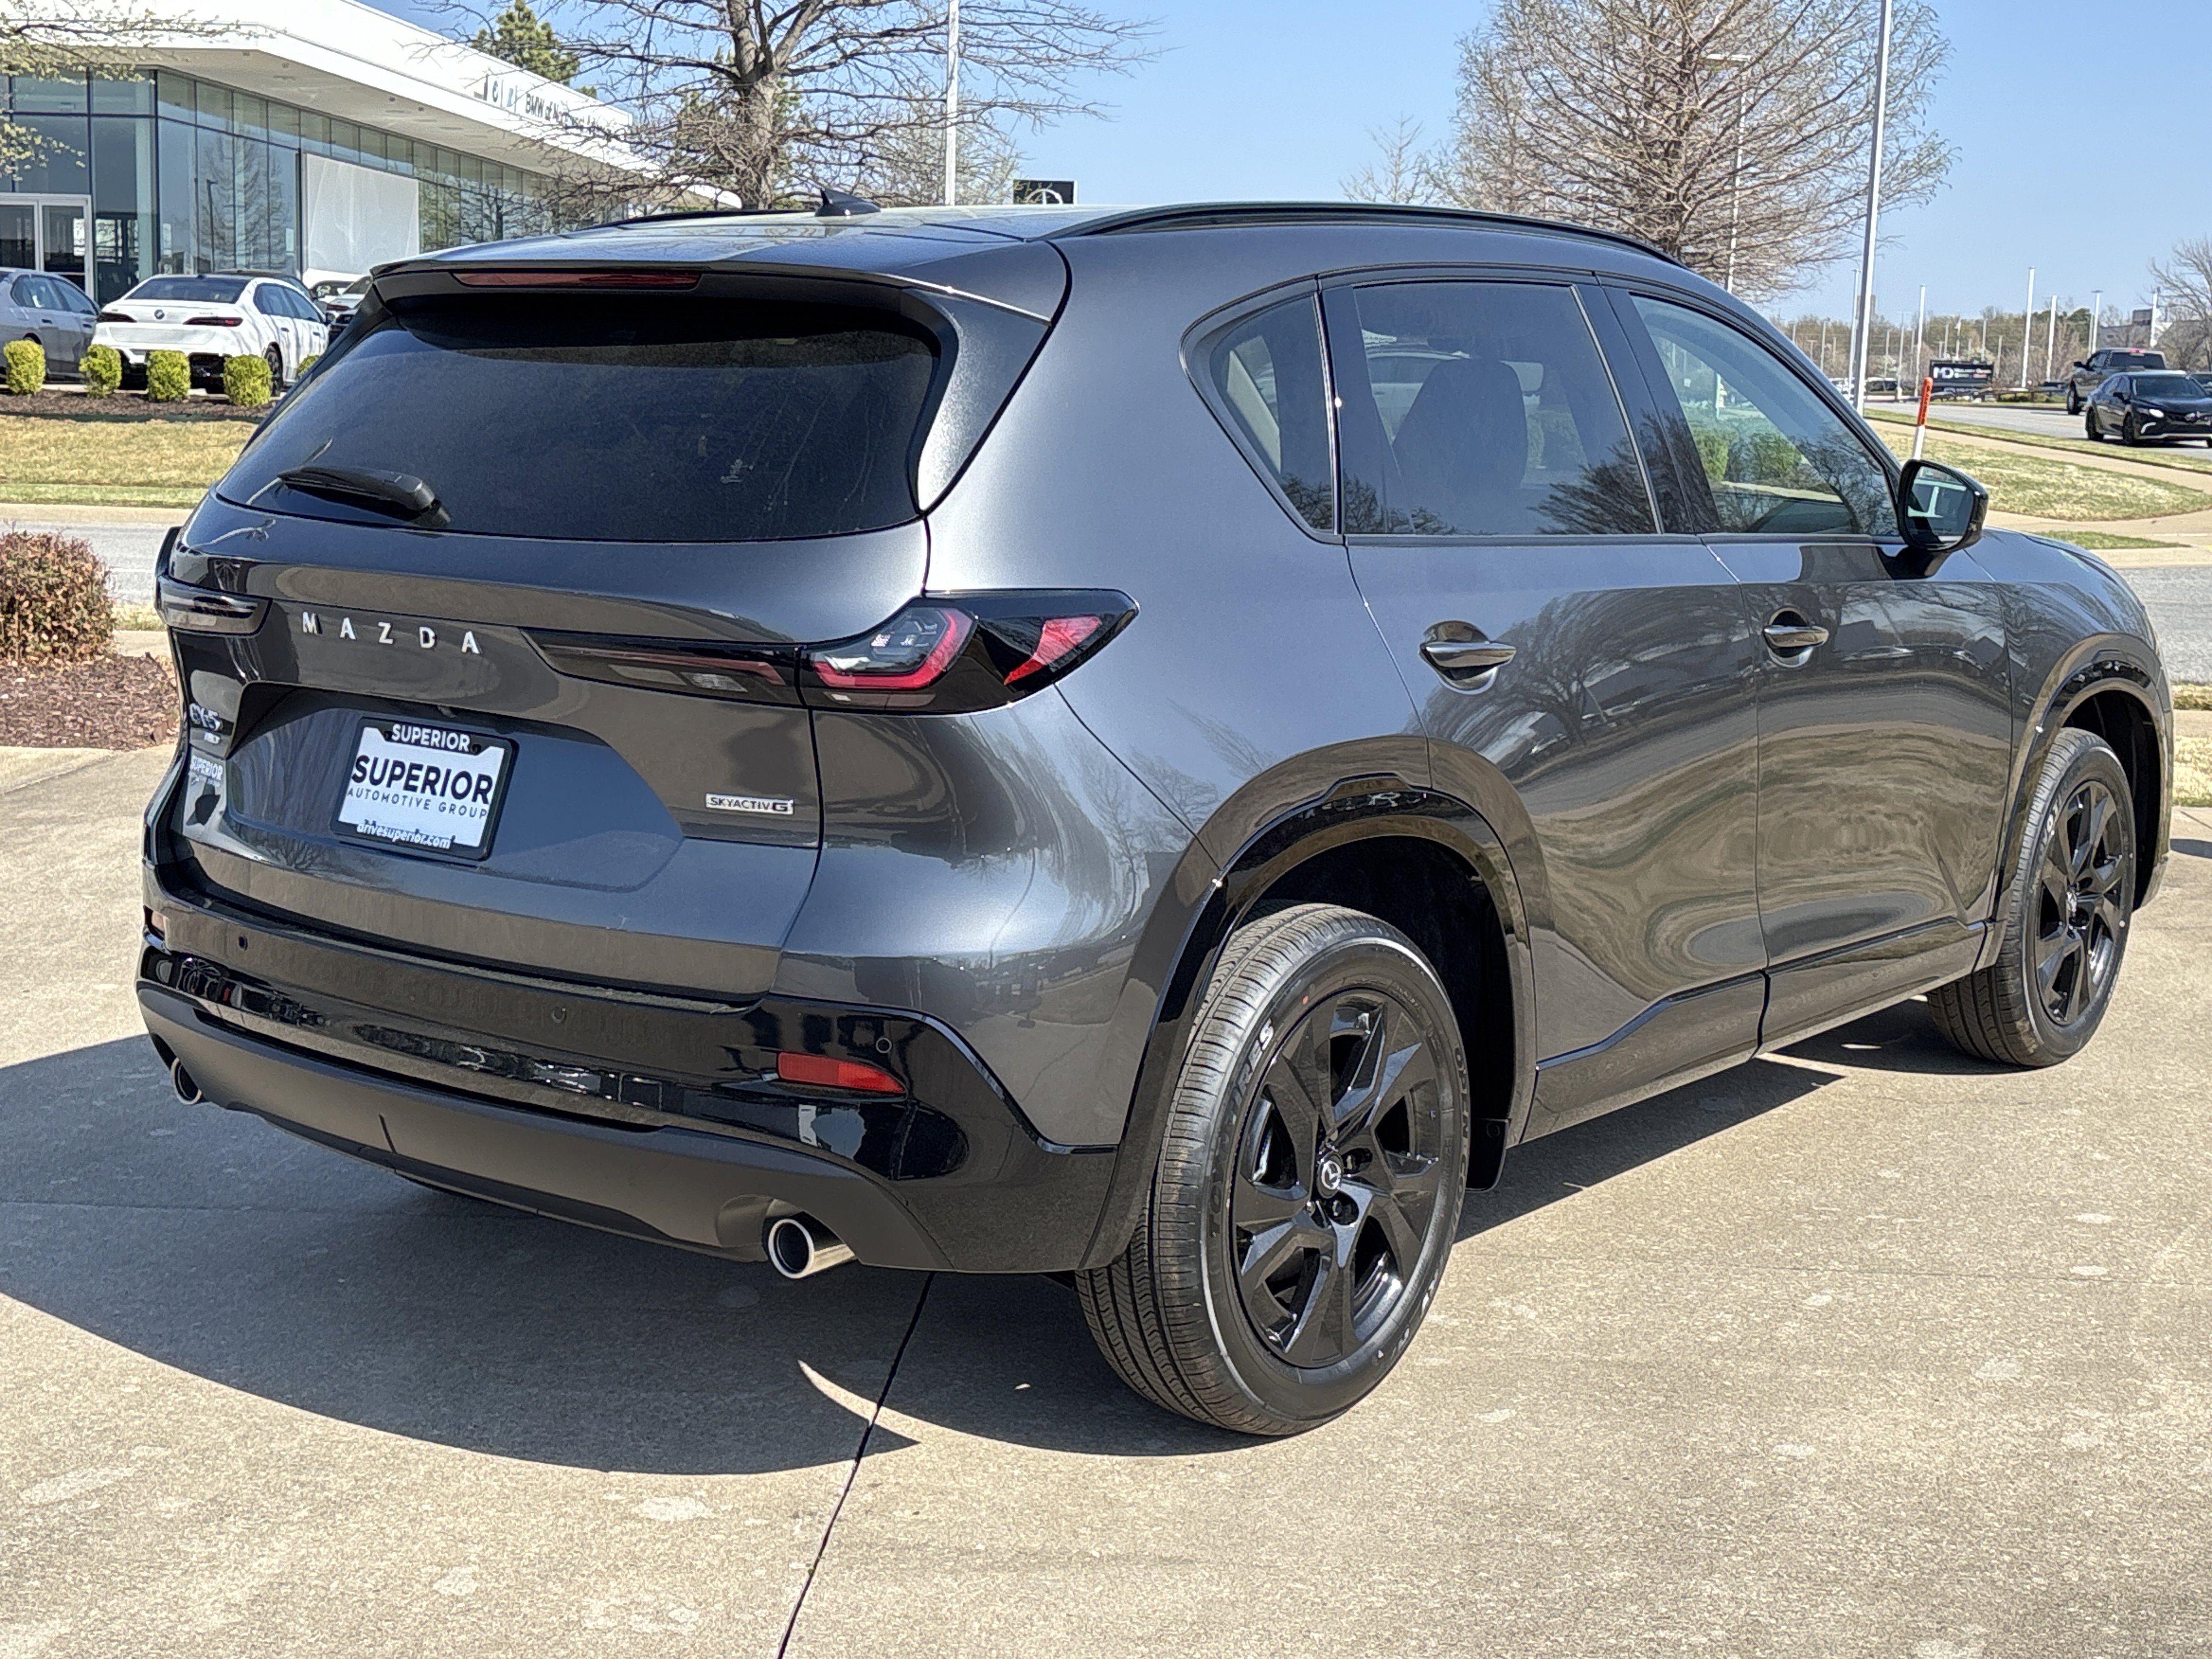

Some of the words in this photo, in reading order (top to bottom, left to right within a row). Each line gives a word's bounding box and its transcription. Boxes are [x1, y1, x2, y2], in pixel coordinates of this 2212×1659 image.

[525, 93, 545, 118] BMW
[302, 611, 483, 655] MAZDA
[391, 724, 471, 752] SUPERIOR
[352, 755, 493, 805] SUPERIOR
[347, 788, 431, 810] AUTOMOTIVE
[438, 802, 488, 820] GROUP
[357, 821, 452, 849] drivesuperior.com
[1228, 1018, 1274, 1126] TIRES
